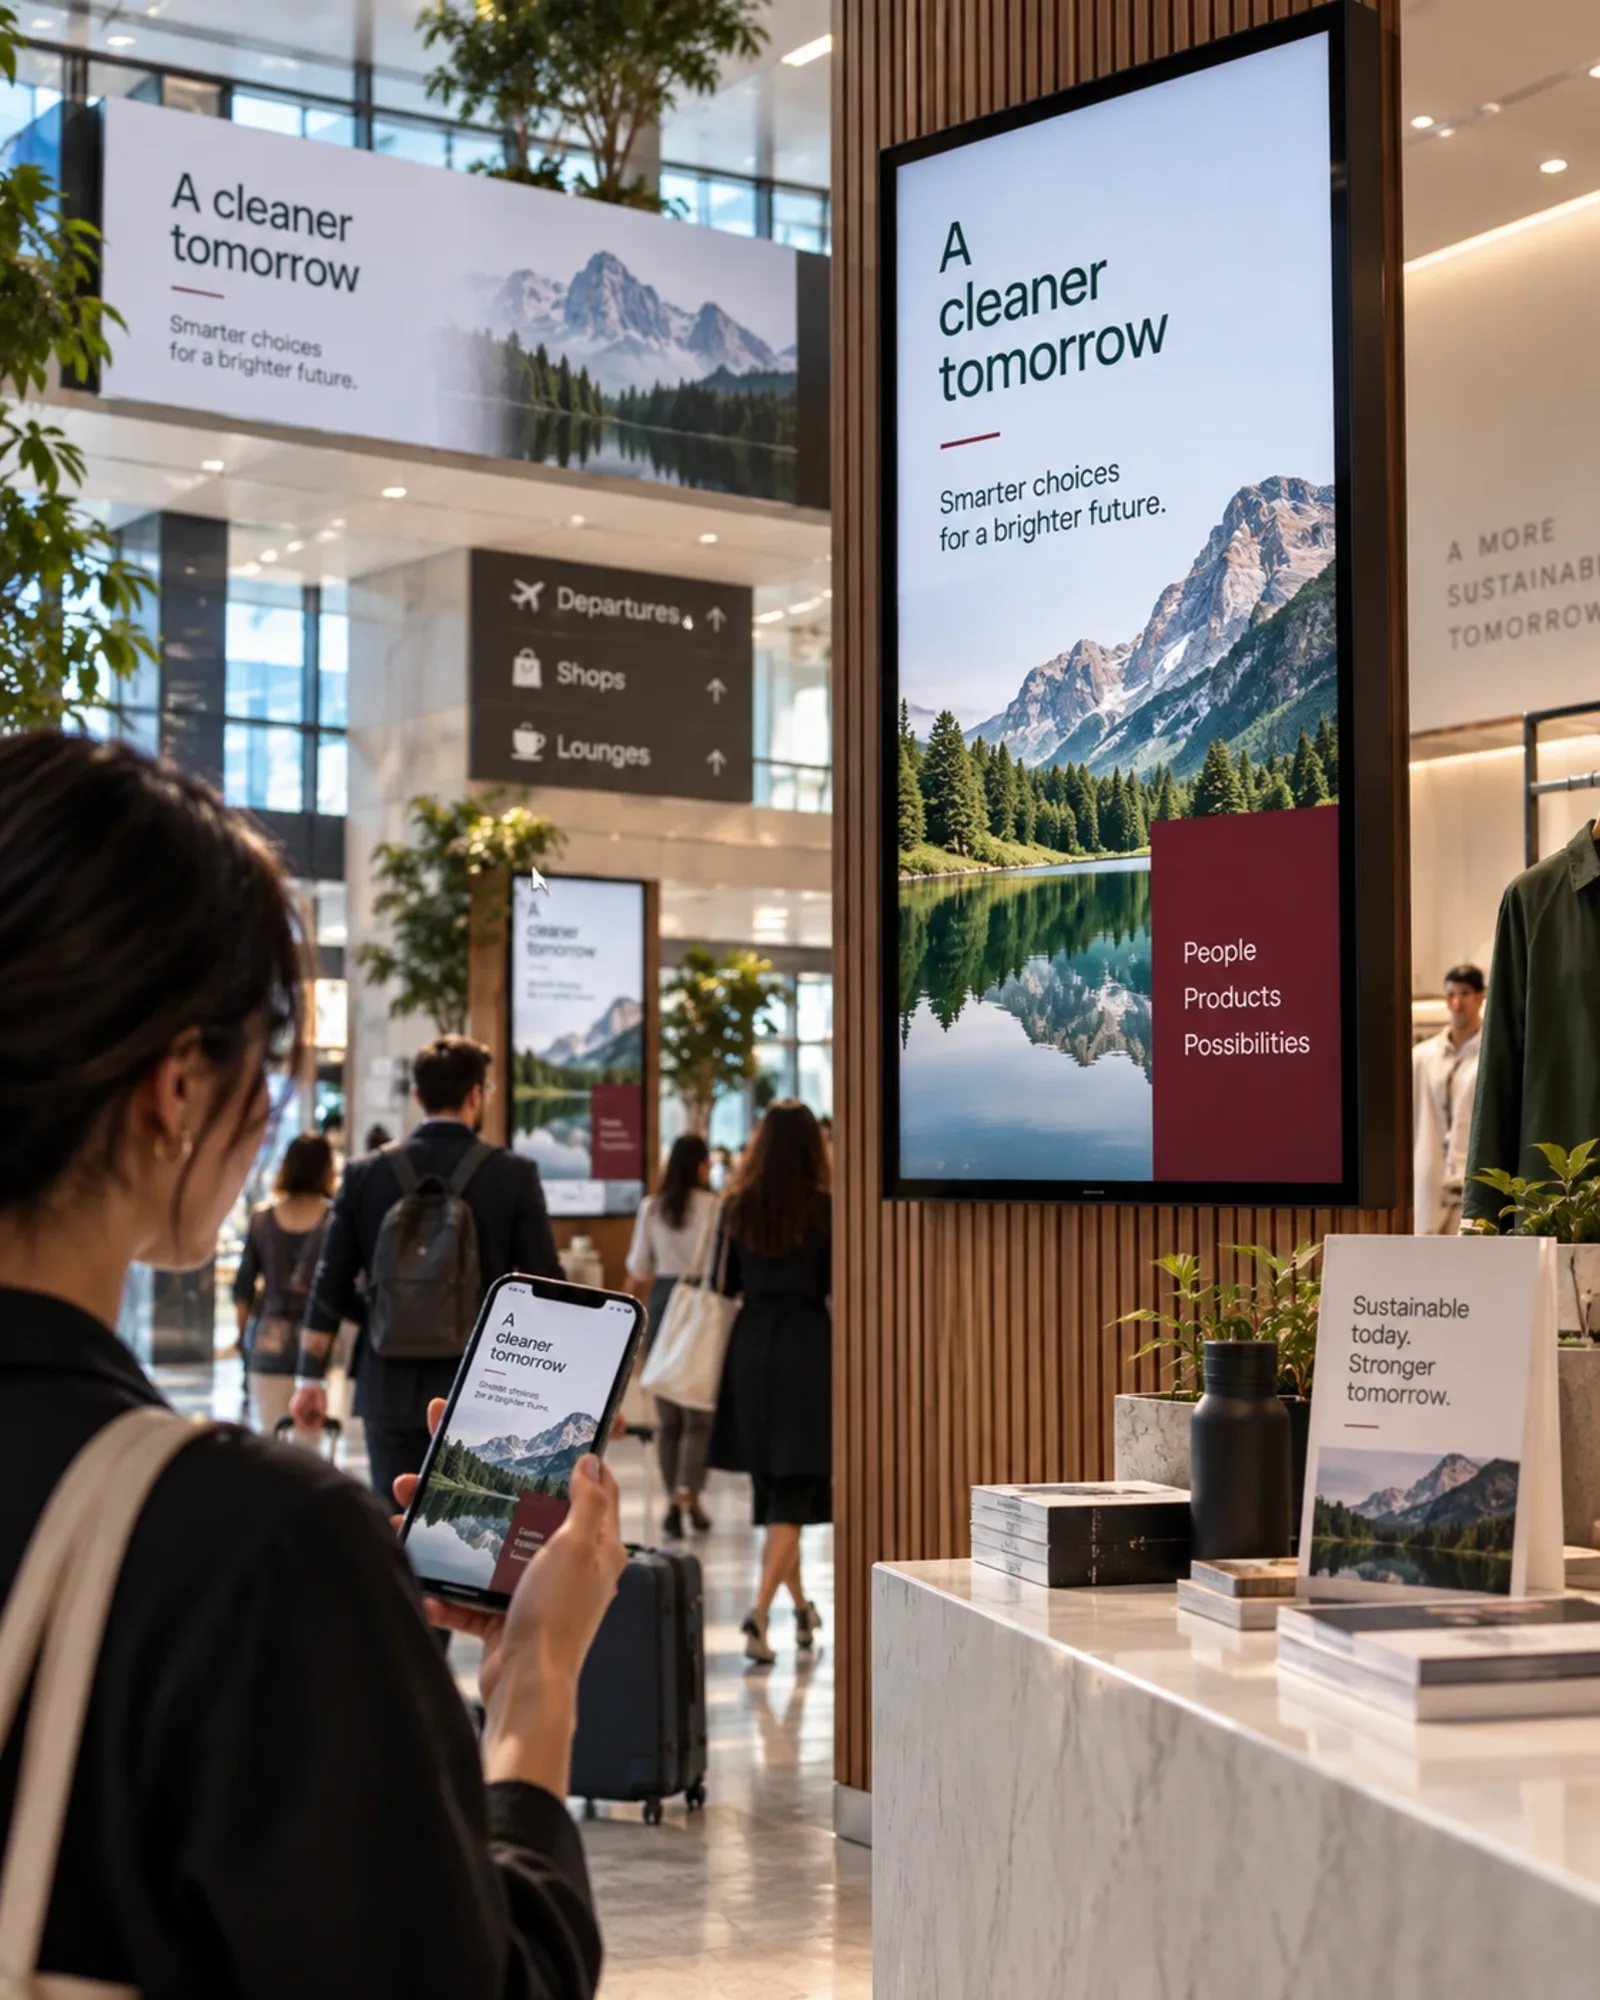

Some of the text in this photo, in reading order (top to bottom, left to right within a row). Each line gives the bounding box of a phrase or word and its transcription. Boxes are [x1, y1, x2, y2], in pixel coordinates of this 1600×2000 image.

[171, 172, 353, 242] A cleaner
[170, 224, 360, 293] tomorrow
[939, 220, 972, 273] A
[939, 259, 1107, 337] cleaner
[169, 315, 322, 358] Smarter choices
[169, 342, 359, 390] for a brighter future.
[939, 313, 1169, 401] tomorrow
[940, 463, 1120, 514] Smarter choices
[940, 494, 1166, 552] for a brighter future.
[1447, 517, 1555, 565] A MORE
[1448, 554, 1600, 608] SUSTAINAB
[557, 586, 680, 626] Departures
[1449, 601, 1600, 651] TOMORROW
[557, 660, 626, 693] Shops
[557, 733, 651, 769] Lounges
[1184, 938, 1257, 967] People
[1184, 985, 1282, 1010] Products
[1184, 1031, 1311, 1056] Possibilities
[502, 1312, 515, 1327] A
[1353, 1295, 1470, 1319] Sustainable
[495, 1331, 554, 1353] cleaner
[1351, 1324, 1412, 1350] today.
[490, 1346, 567, 1374] tomorrow
[1349, 1353, 1436, 1381] Stronger
[1347, 1382, 1451, 1407] tomorrow.
